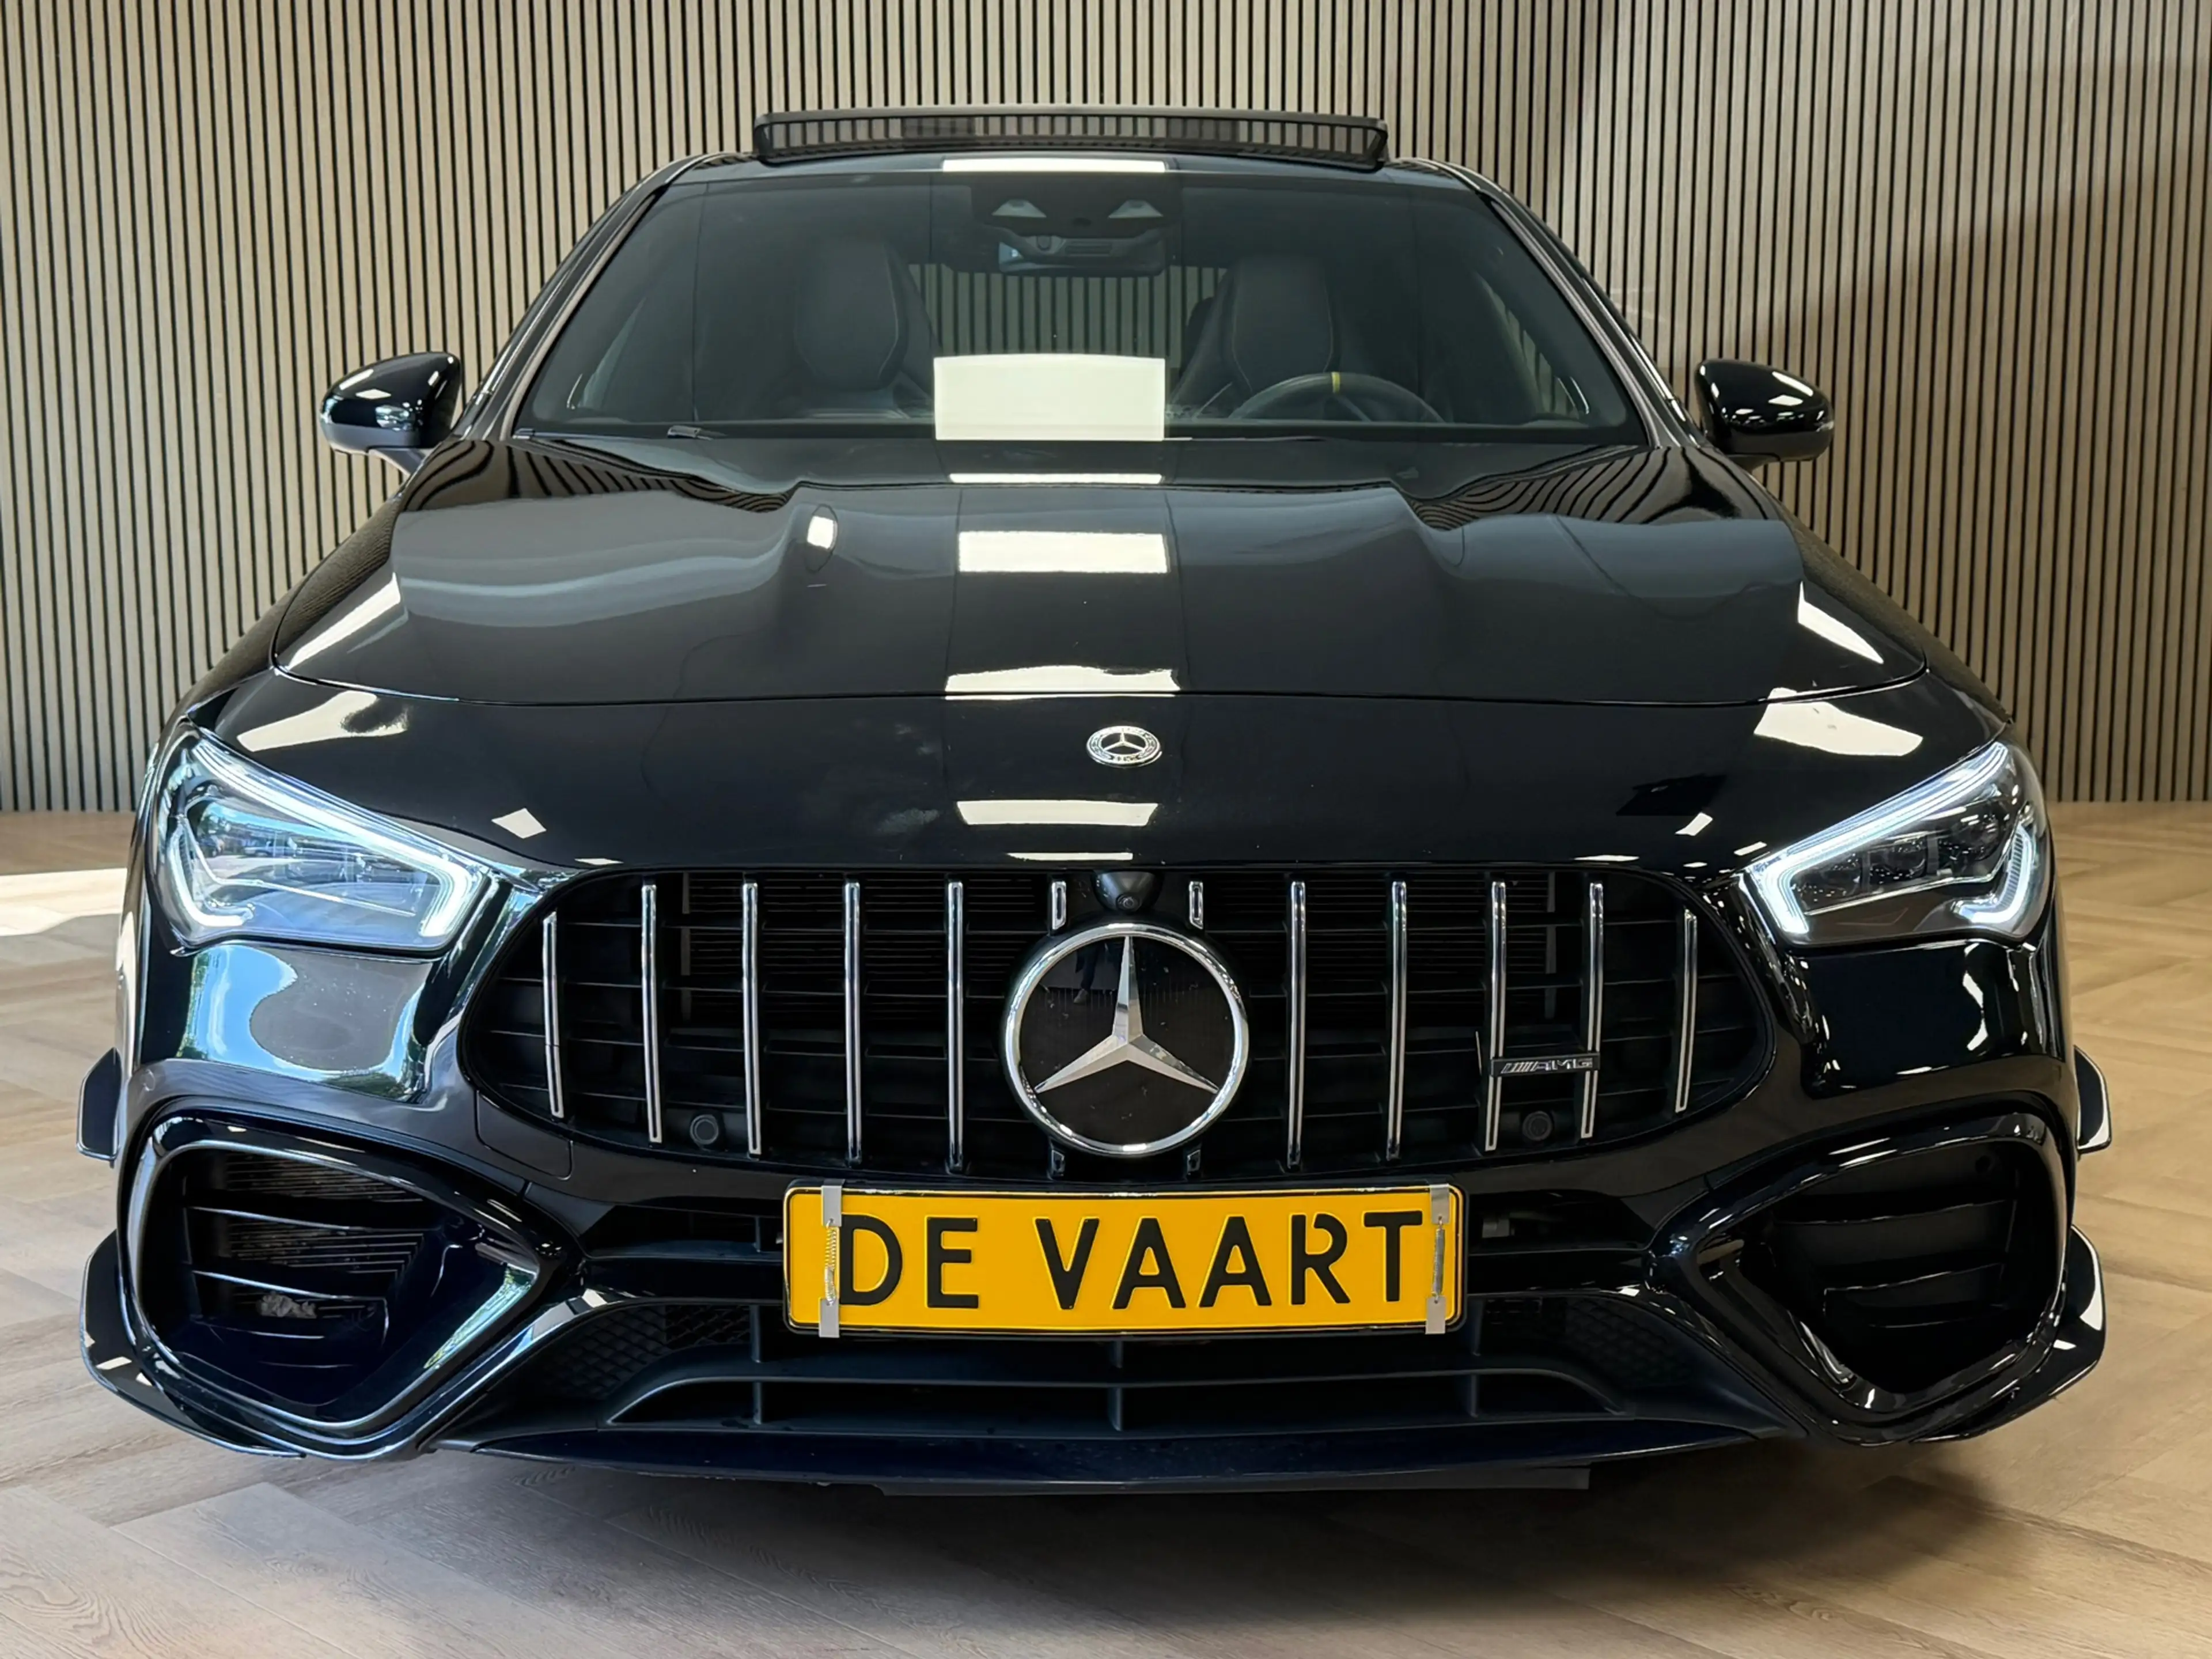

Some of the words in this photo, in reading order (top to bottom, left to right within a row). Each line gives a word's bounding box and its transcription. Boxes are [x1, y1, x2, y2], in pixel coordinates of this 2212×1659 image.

[1529, 1057, 1593, 1072] AMG
[838, 1214, 979, 1309] DE
[1035, 1210, 1423, 1310] VAART
